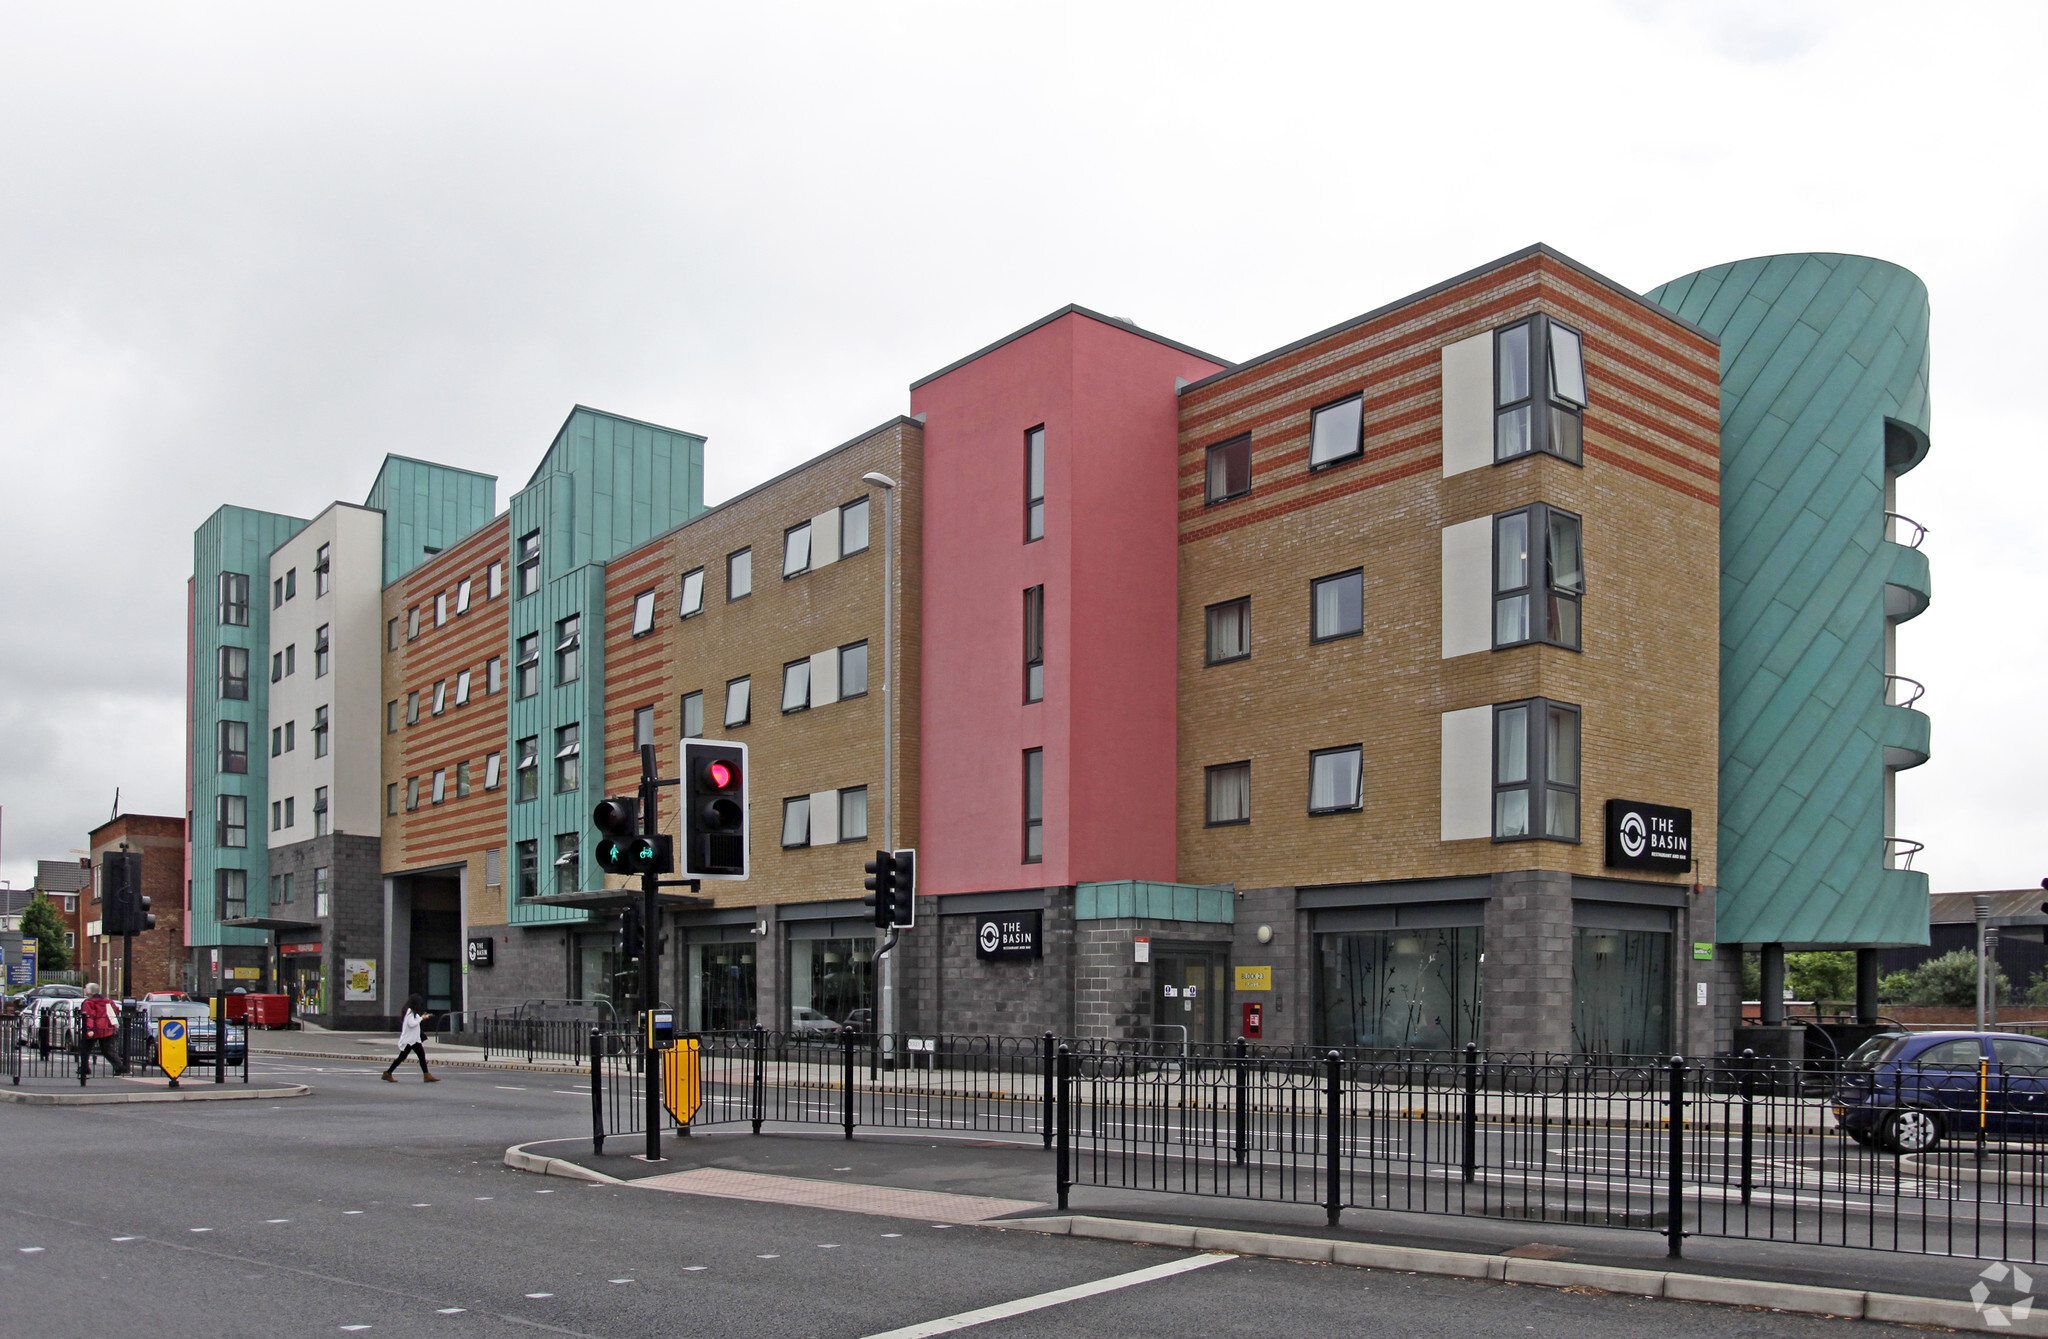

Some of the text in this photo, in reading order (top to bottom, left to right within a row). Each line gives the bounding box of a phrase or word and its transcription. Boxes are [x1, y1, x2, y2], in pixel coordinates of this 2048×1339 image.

[1651, 817, 1673, 833] THE
[1651, 834, 1687, 850] BASIN
[1003, 922, 1020, 932] THE
[1003, 933, 1031, 943] BASIN
